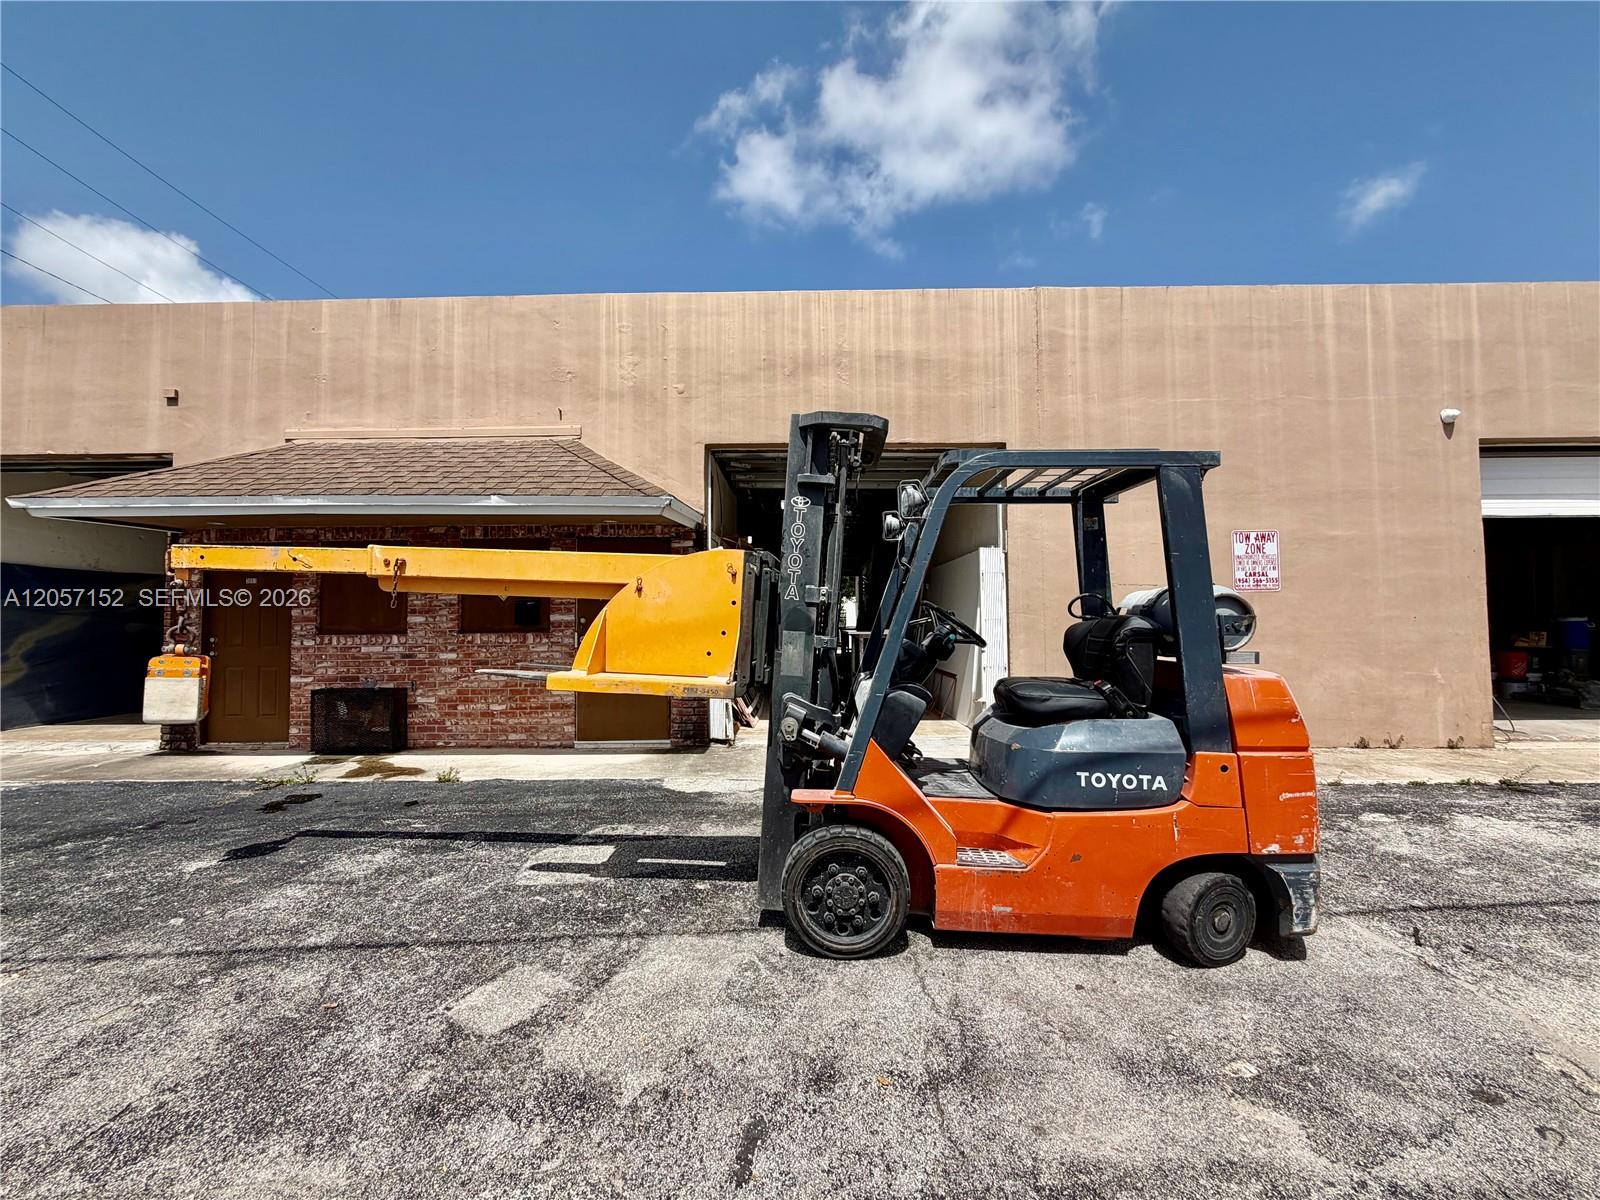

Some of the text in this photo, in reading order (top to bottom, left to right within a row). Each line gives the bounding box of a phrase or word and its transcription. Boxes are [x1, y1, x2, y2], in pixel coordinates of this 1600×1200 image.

[1234, 532, 1275, 543] TOW AWAY
[783, 507, 808, 601] TOYOTA
[1245, 543, 1267, 554] ZONE
[1076, 771, 1168, 791] TOYOTA
